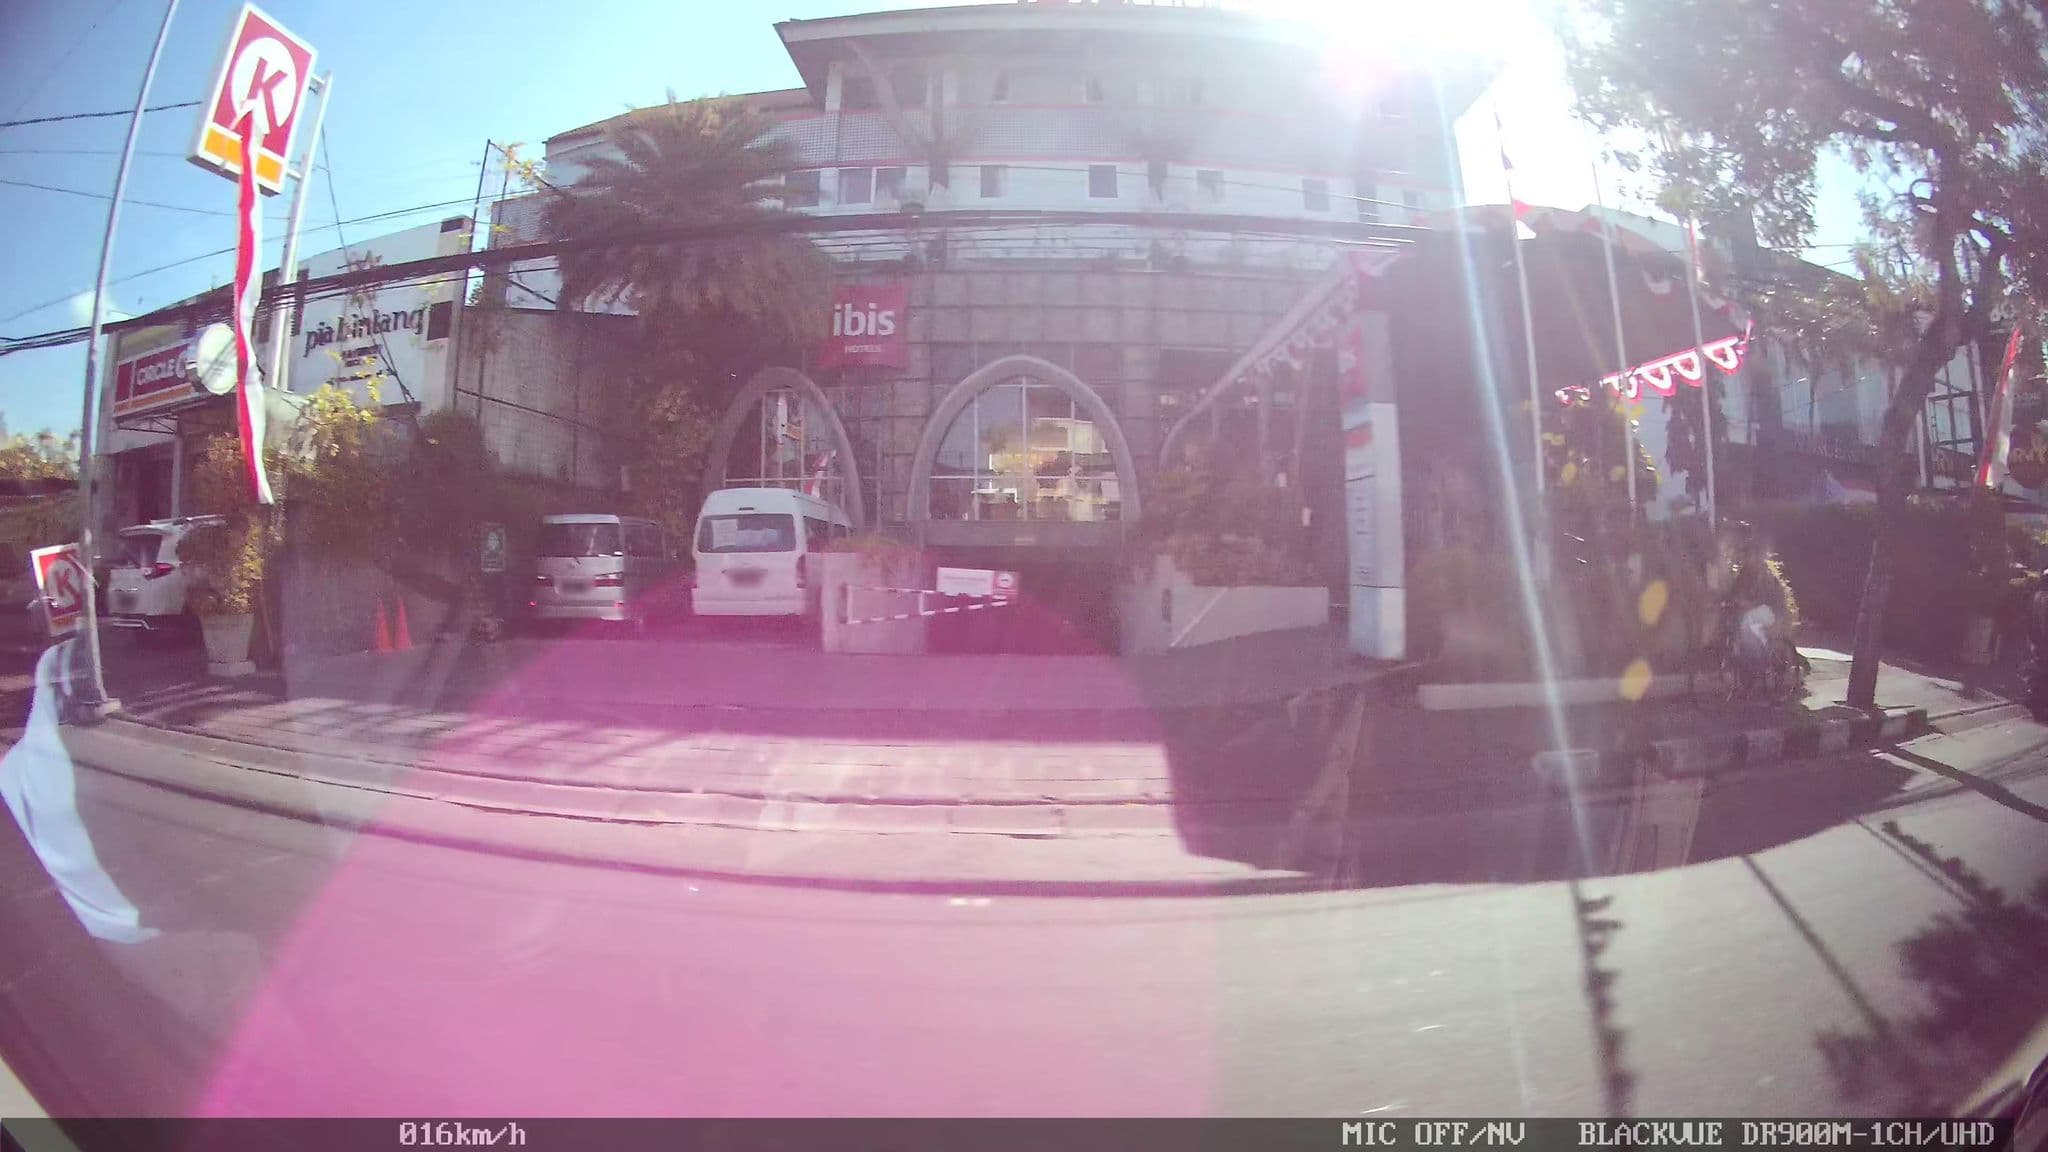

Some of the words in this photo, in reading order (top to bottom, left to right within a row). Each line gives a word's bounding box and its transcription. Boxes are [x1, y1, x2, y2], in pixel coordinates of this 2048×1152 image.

[242, 56, 288, 135] K
[833, 302, 896, 336] ibis
[304, 321, 334, 357] pia
[54, 567, 81, 602] K
